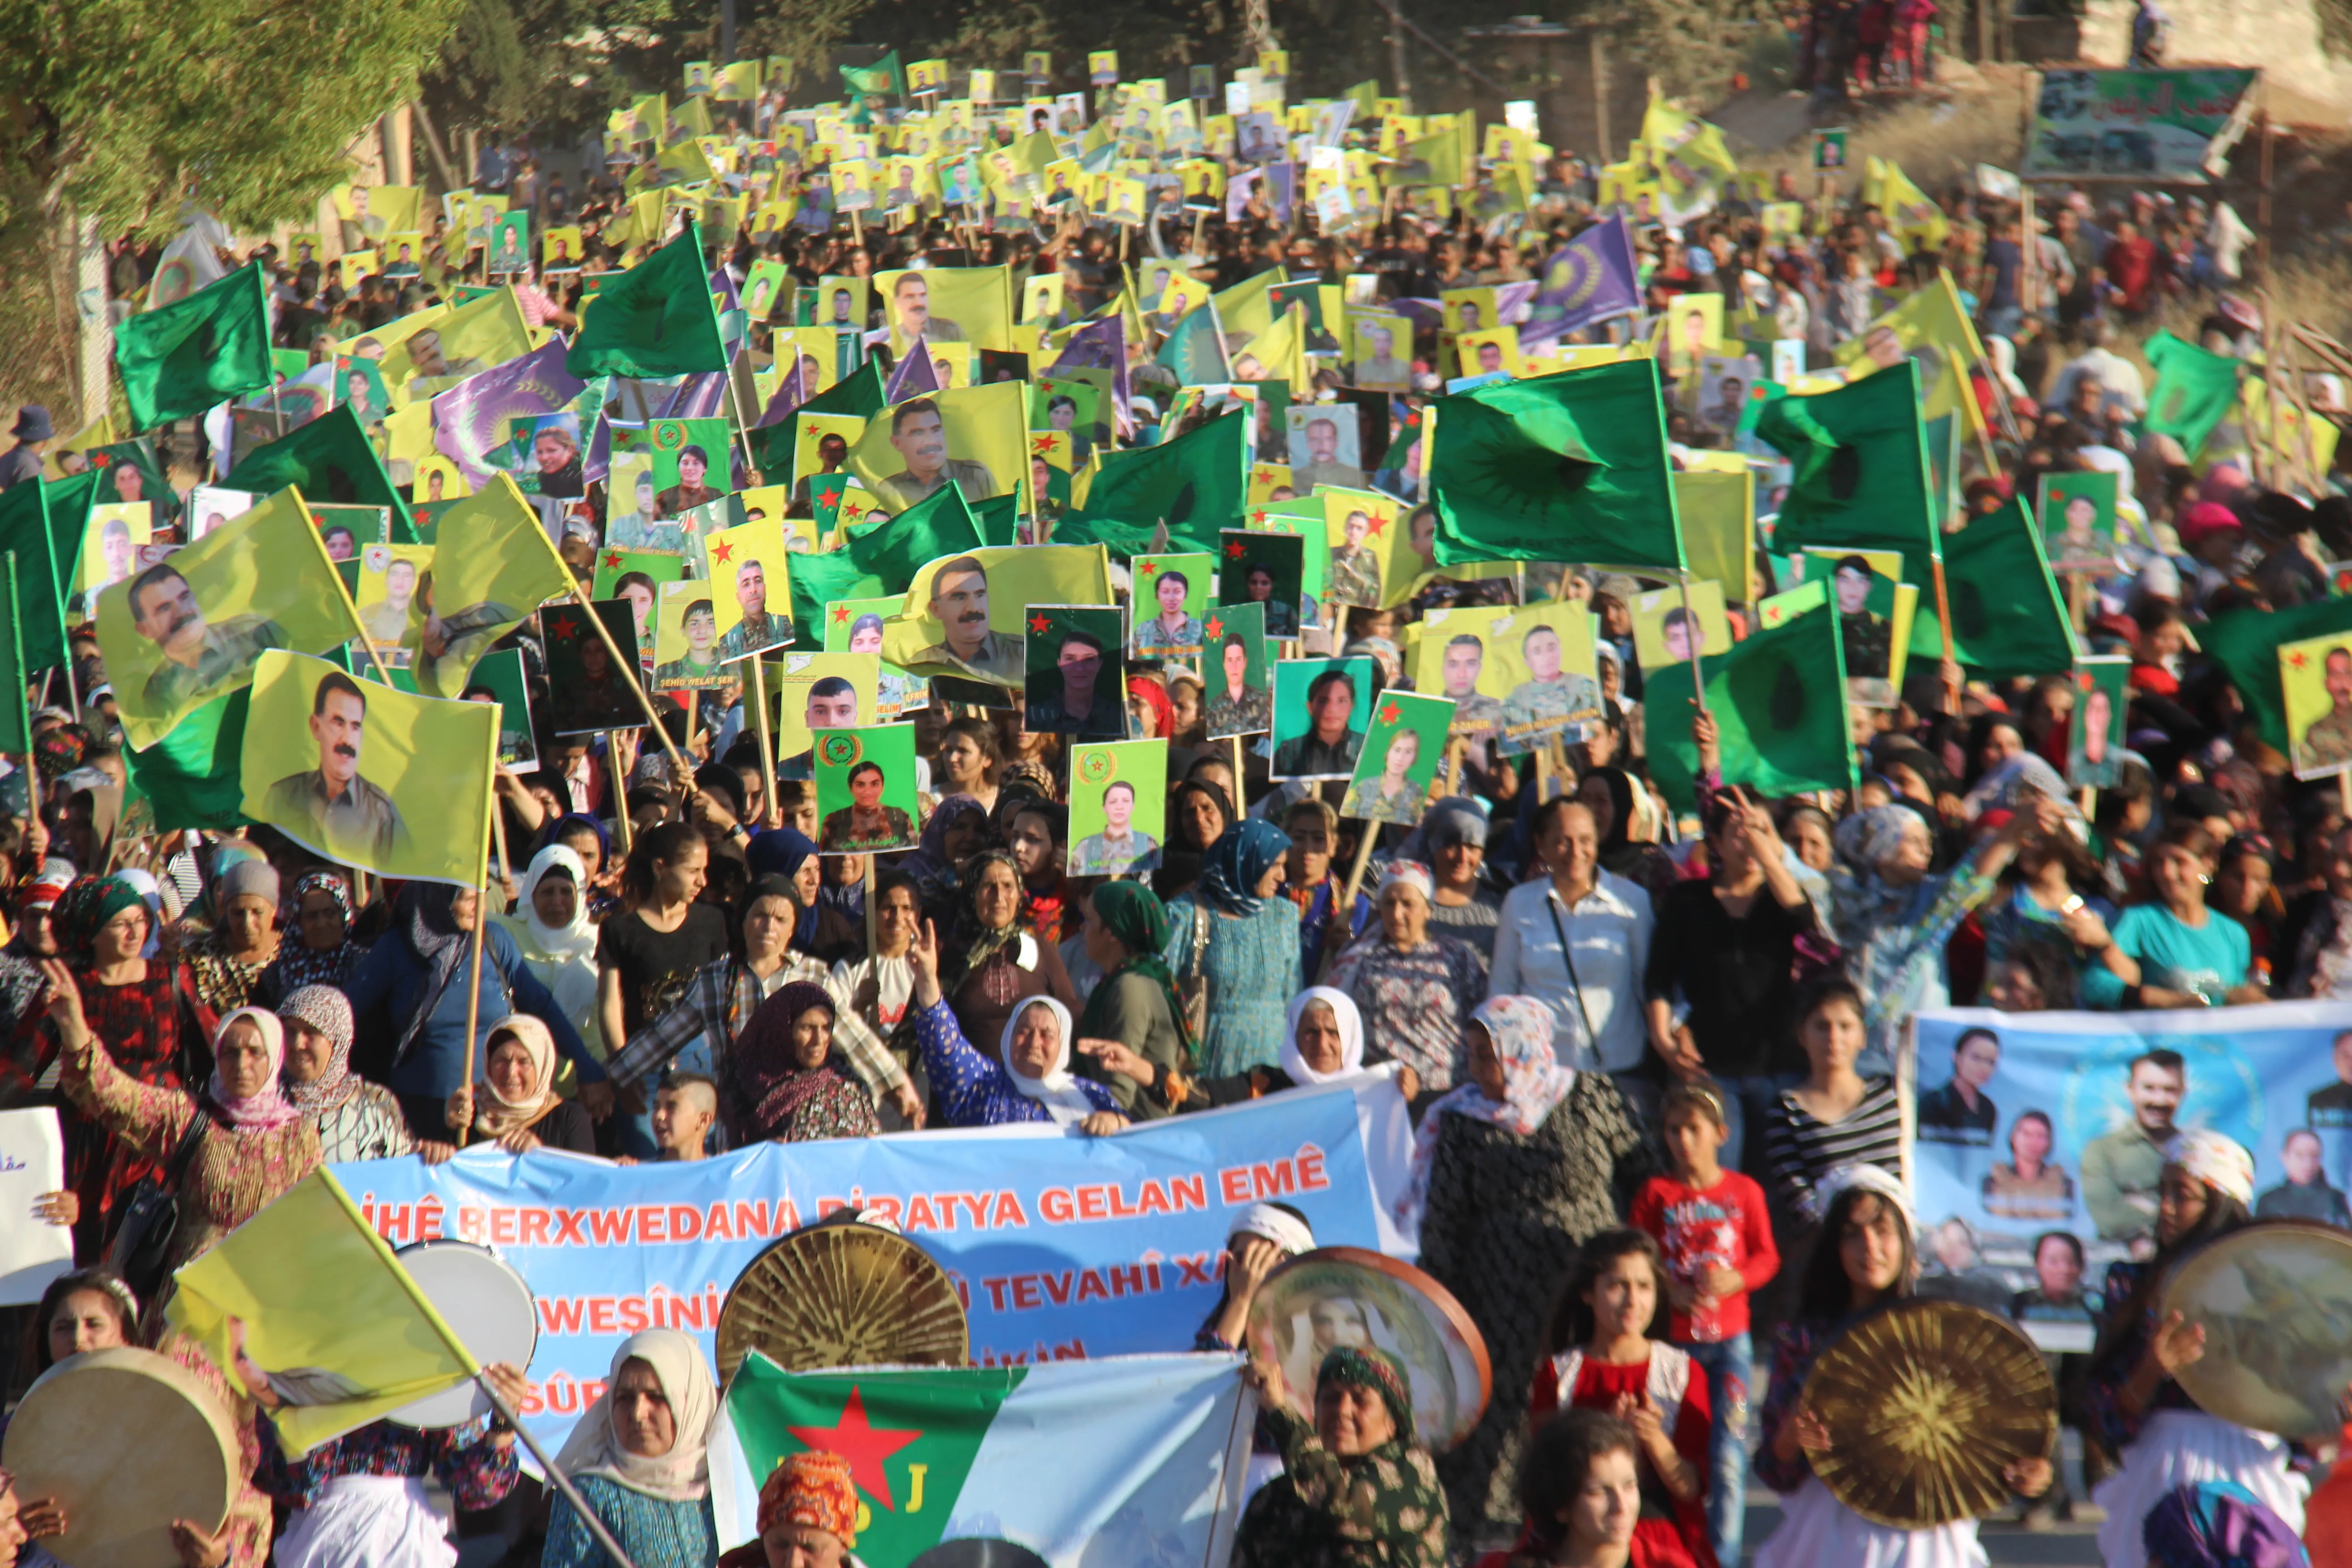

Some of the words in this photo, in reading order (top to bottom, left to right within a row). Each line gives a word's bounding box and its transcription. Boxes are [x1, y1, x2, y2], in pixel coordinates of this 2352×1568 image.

[687, 676, 715, 686] WELAT
[360, 1192, 445, 1243] İHÊ
[457, 1198, 802, 1246] BERXWEDANA
[1038, 1172, 1207, 1225] GELAN
[1218, 1140, 1330, 1206] EMÊ
[981, 1248, 1164, 1313] TEVAHÎ
